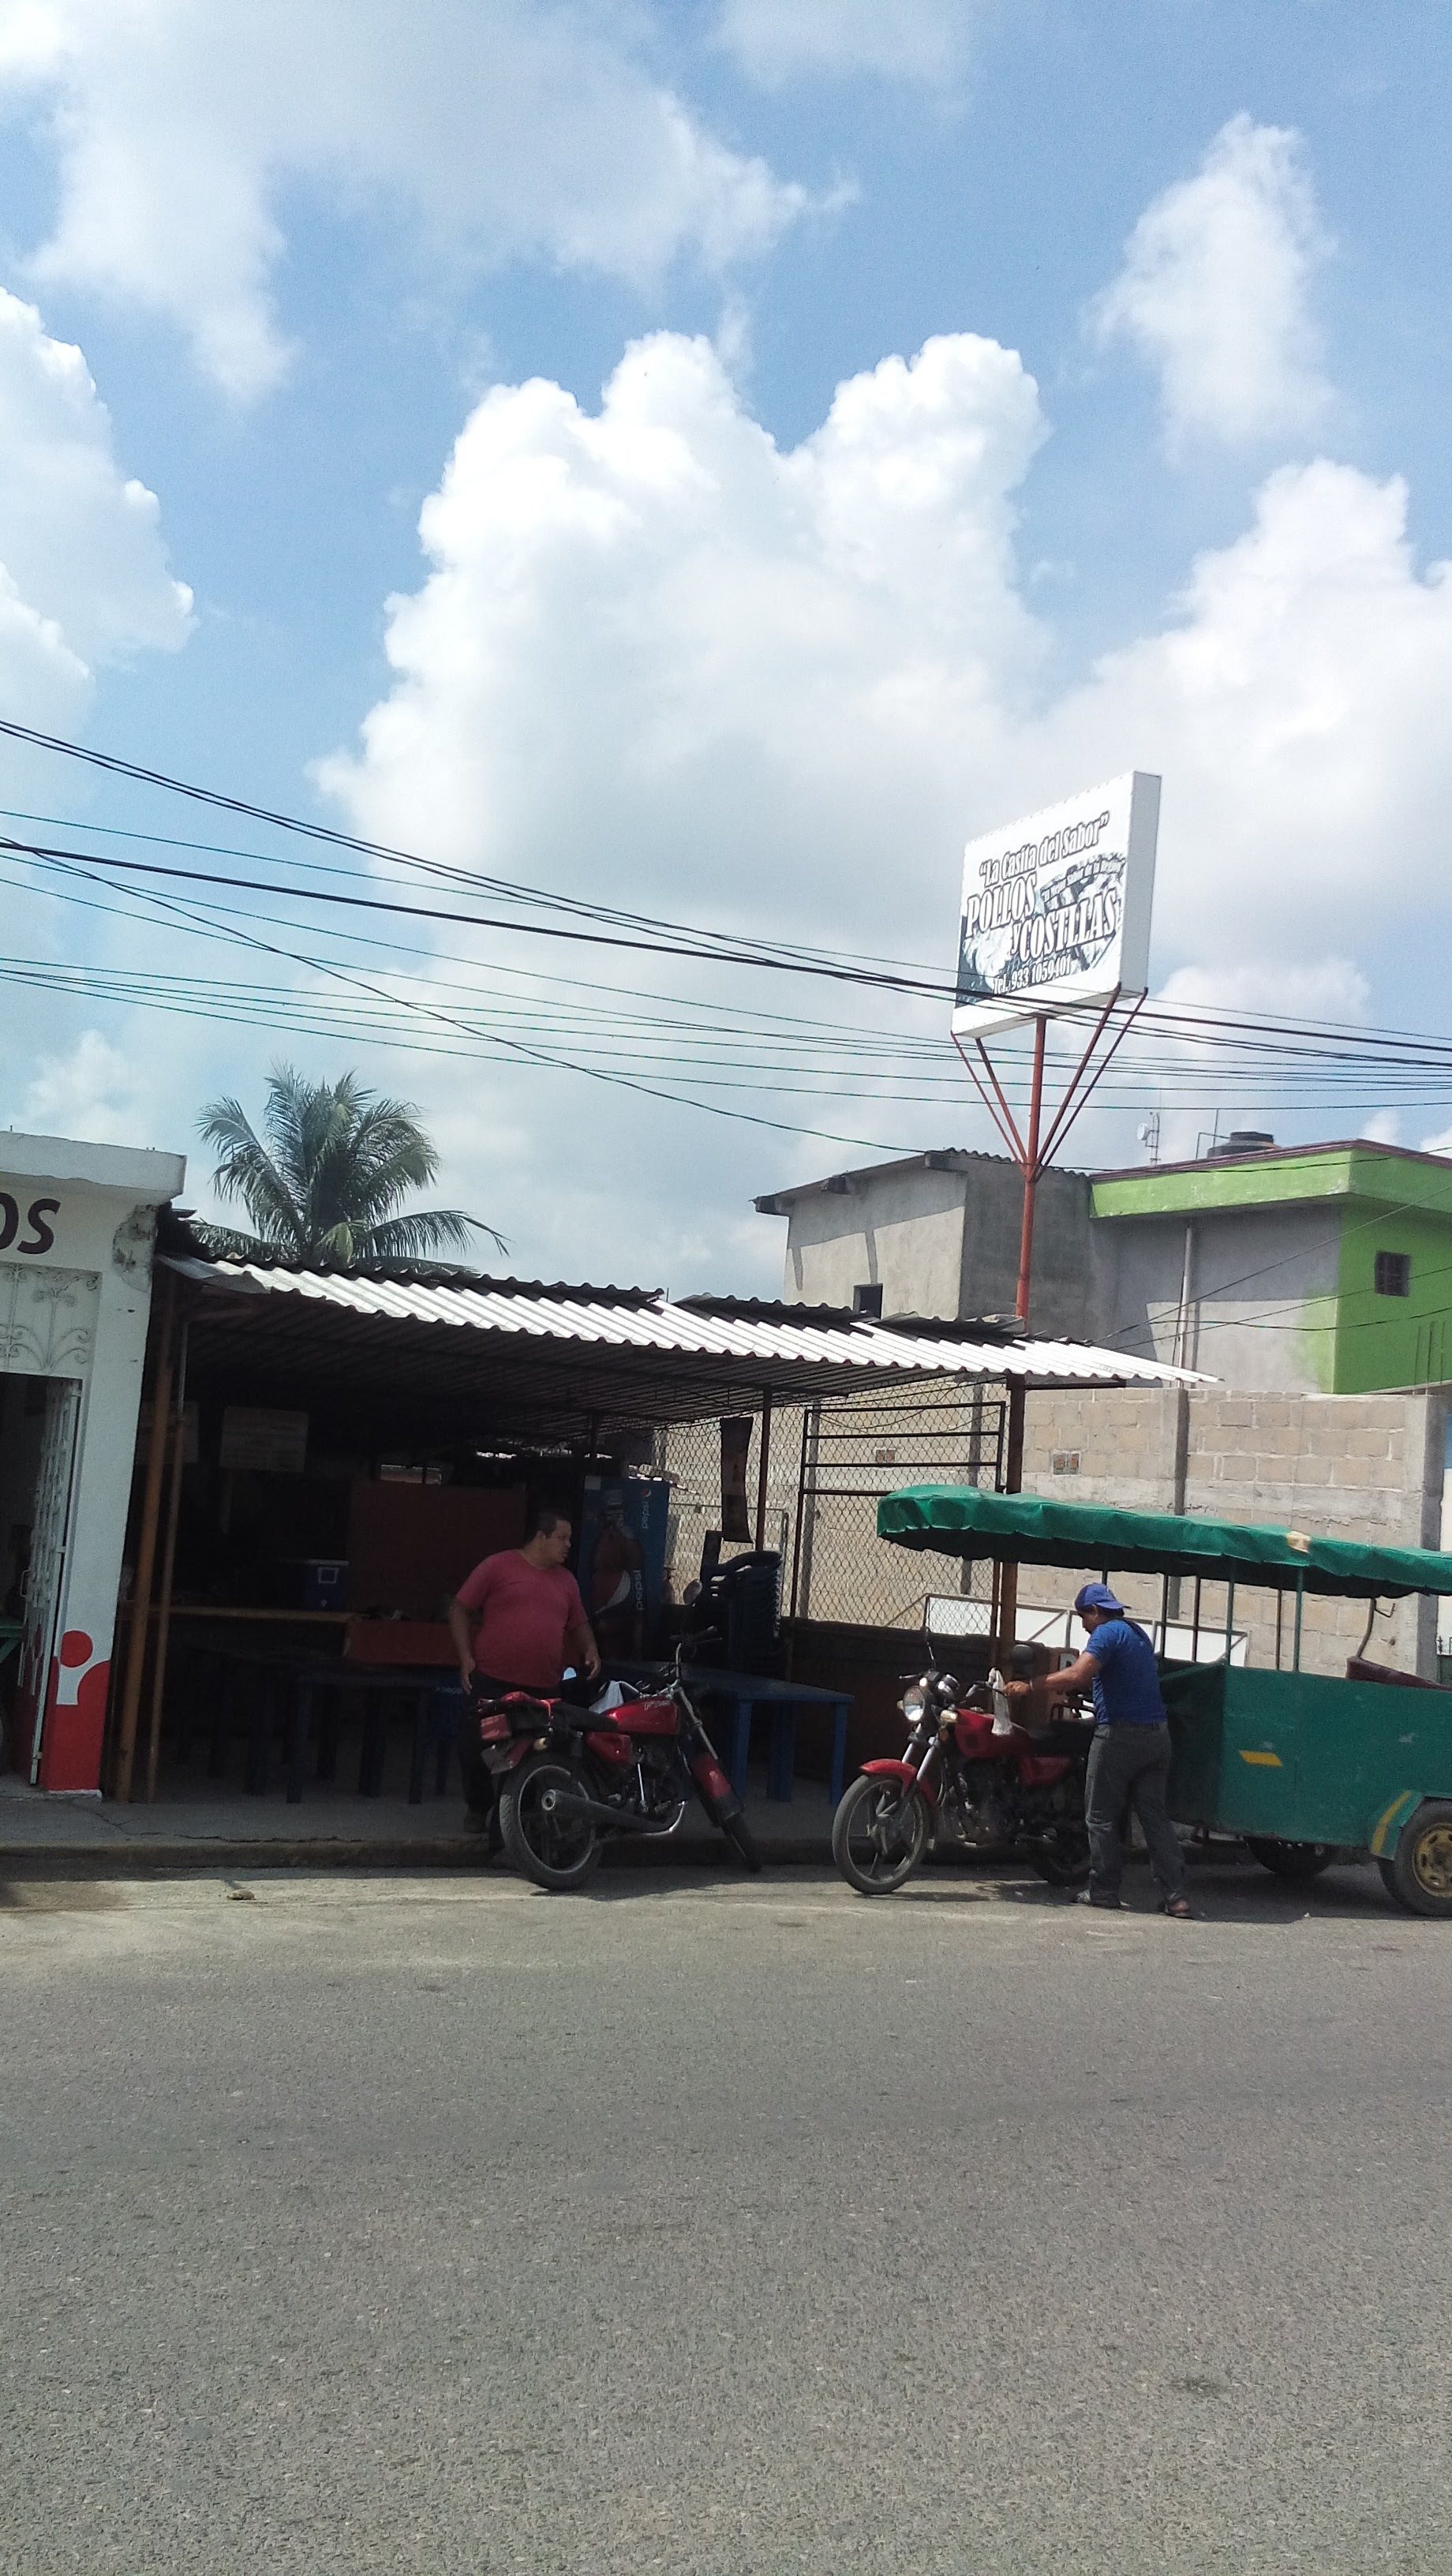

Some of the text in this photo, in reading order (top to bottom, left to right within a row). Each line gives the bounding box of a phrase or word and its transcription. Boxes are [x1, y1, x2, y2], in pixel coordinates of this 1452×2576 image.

[1001, 843, 1038, 882] Casita
[1038, 831, 1061, 867] del
[965, 871, 1037, 938] POLLOS
[1019, 886, 1117, 963] COSTILLAS
[1011, 967, 1030, 990] 933
[641, 1501, 651, 1529] pepsi
[634, 1569, 645, 1611] pepsi
